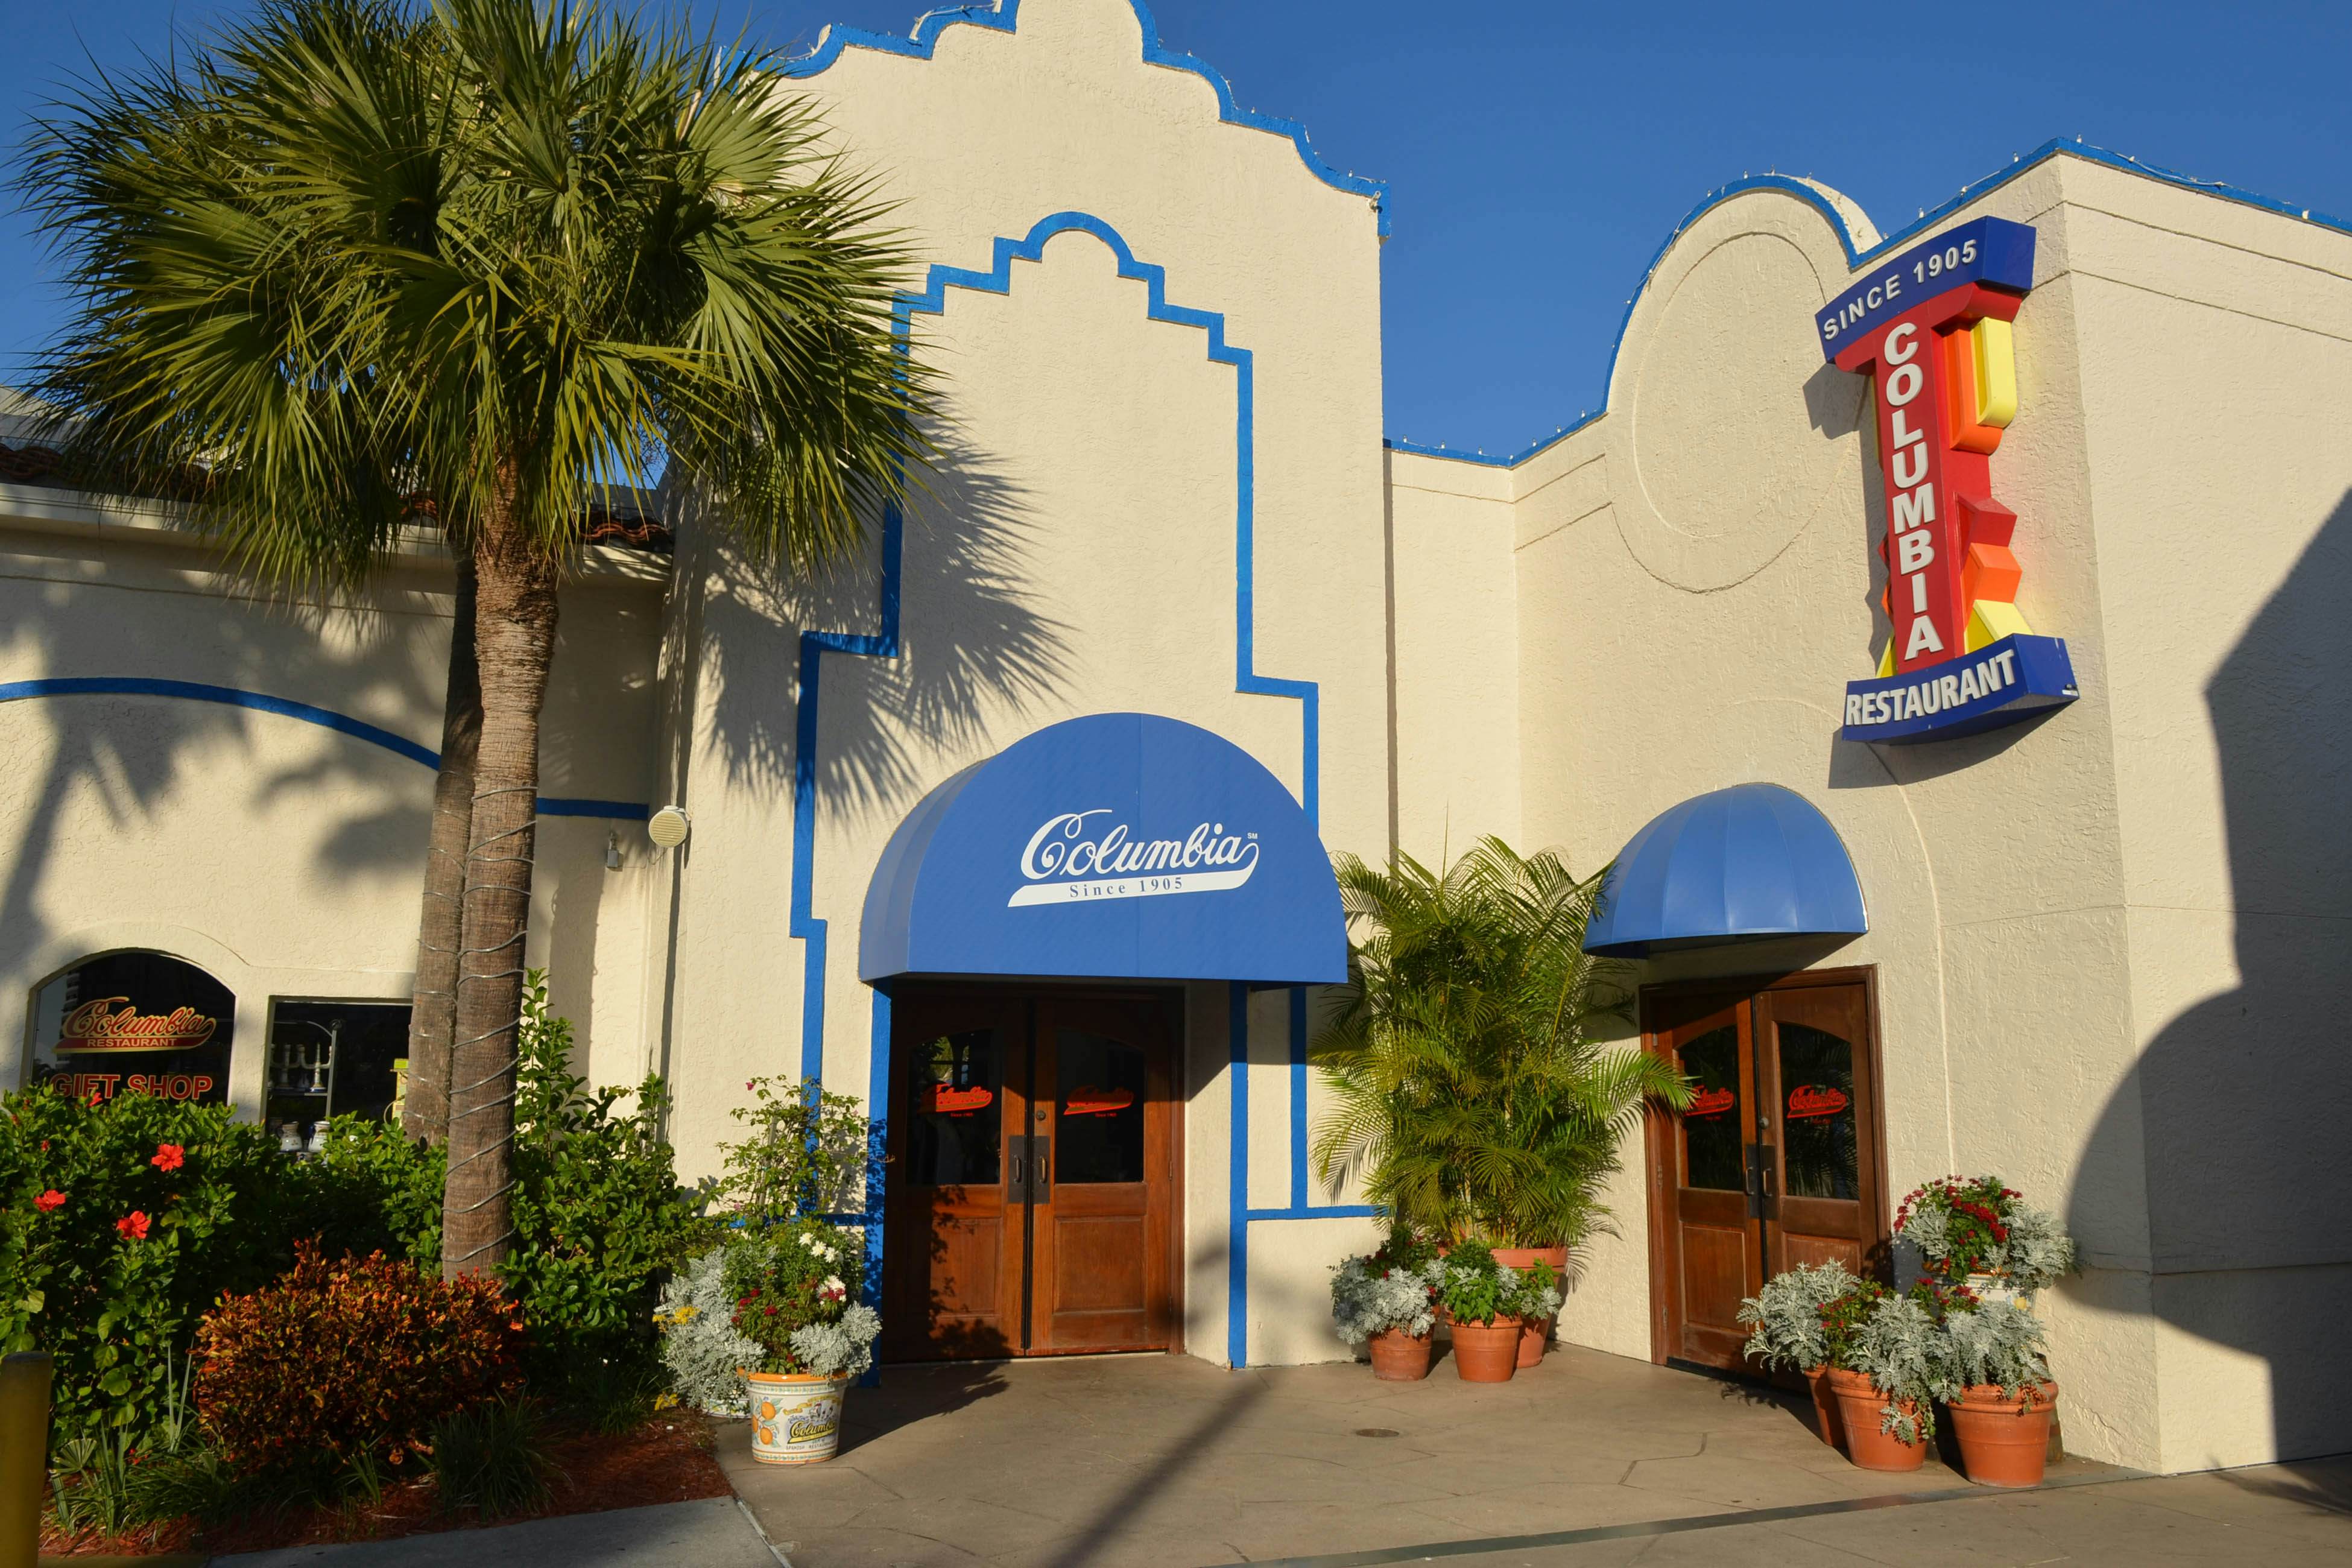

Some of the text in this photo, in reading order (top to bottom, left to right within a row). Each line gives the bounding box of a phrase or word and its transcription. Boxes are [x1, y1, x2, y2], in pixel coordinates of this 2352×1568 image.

[1822, 238, 1977, 341] SINCE 1905
[1883, 321, 1944, 662] COLUMBIA
[1845, 649, 2015, 726] RESTAURANT
[1020, 809, 1259, 880] Columbia
[1069, 877, 1183, 898] Since 1905
[63, 996, 216, 1038] Columbia
[87, 1038, 177, 1048] RESTAURANT
[50, 1073, 213, 1101] GIFT SHOP
